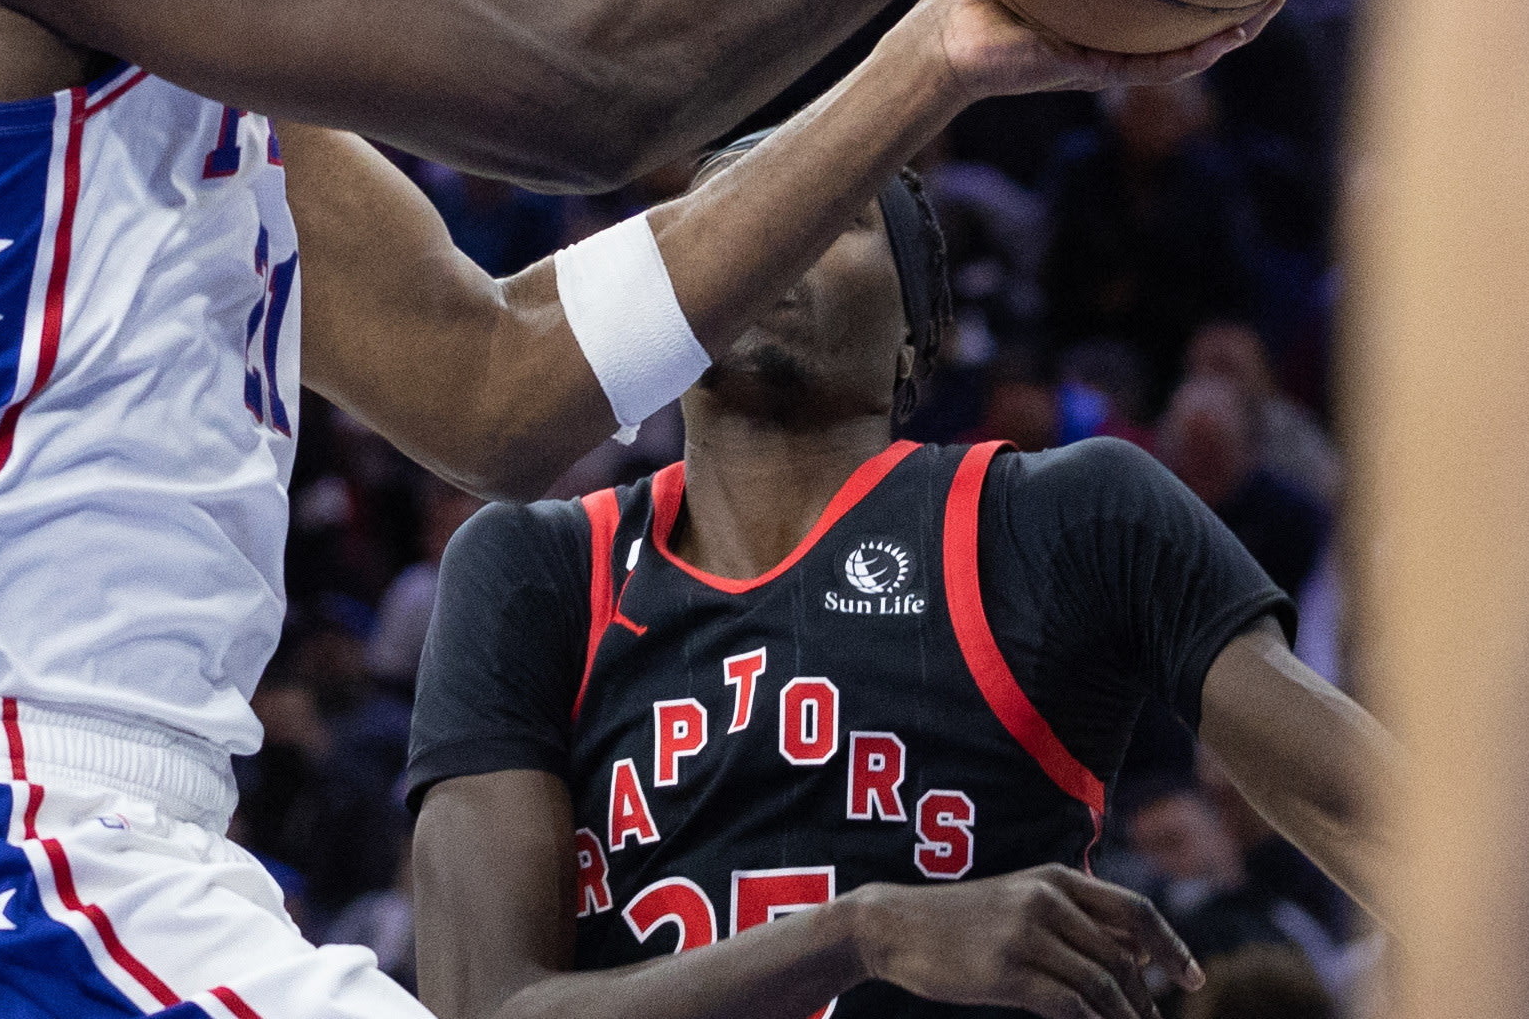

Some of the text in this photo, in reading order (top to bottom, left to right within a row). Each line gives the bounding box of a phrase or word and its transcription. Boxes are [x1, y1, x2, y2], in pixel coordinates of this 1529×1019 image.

[824, 591, 925, 614] Sun Life
[575, 646, 975, 918] RAPTORS
